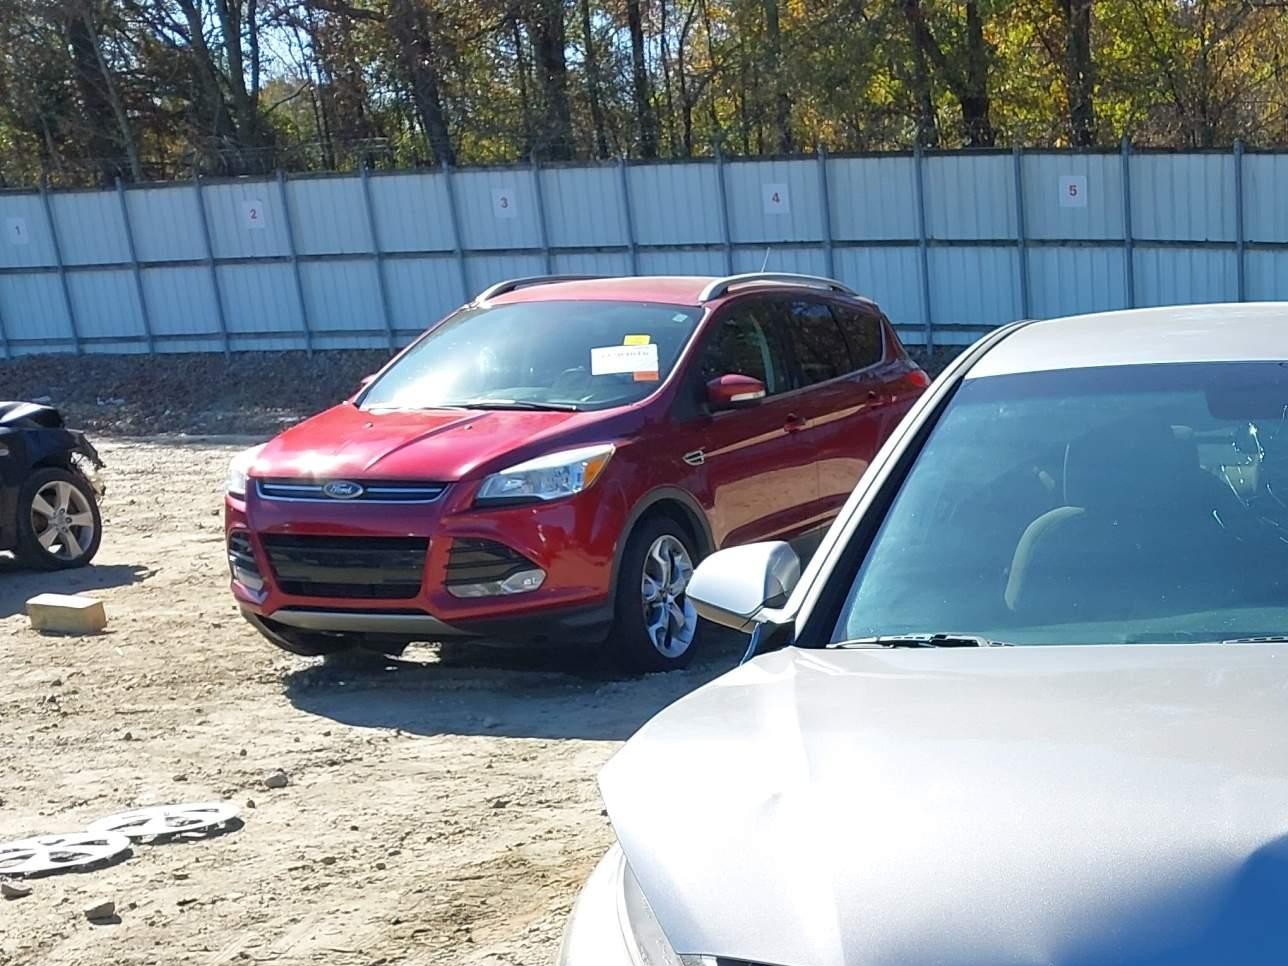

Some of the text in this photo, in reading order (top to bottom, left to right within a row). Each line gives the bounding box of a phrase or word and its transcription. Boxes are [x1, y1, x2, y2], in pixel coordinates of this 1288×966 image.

[1068, 185, 1078, 197] 5
[500, 197, 508, 208] 3
[772, 192, 780, 203] 4
[249, 208, 257, 219] 2
